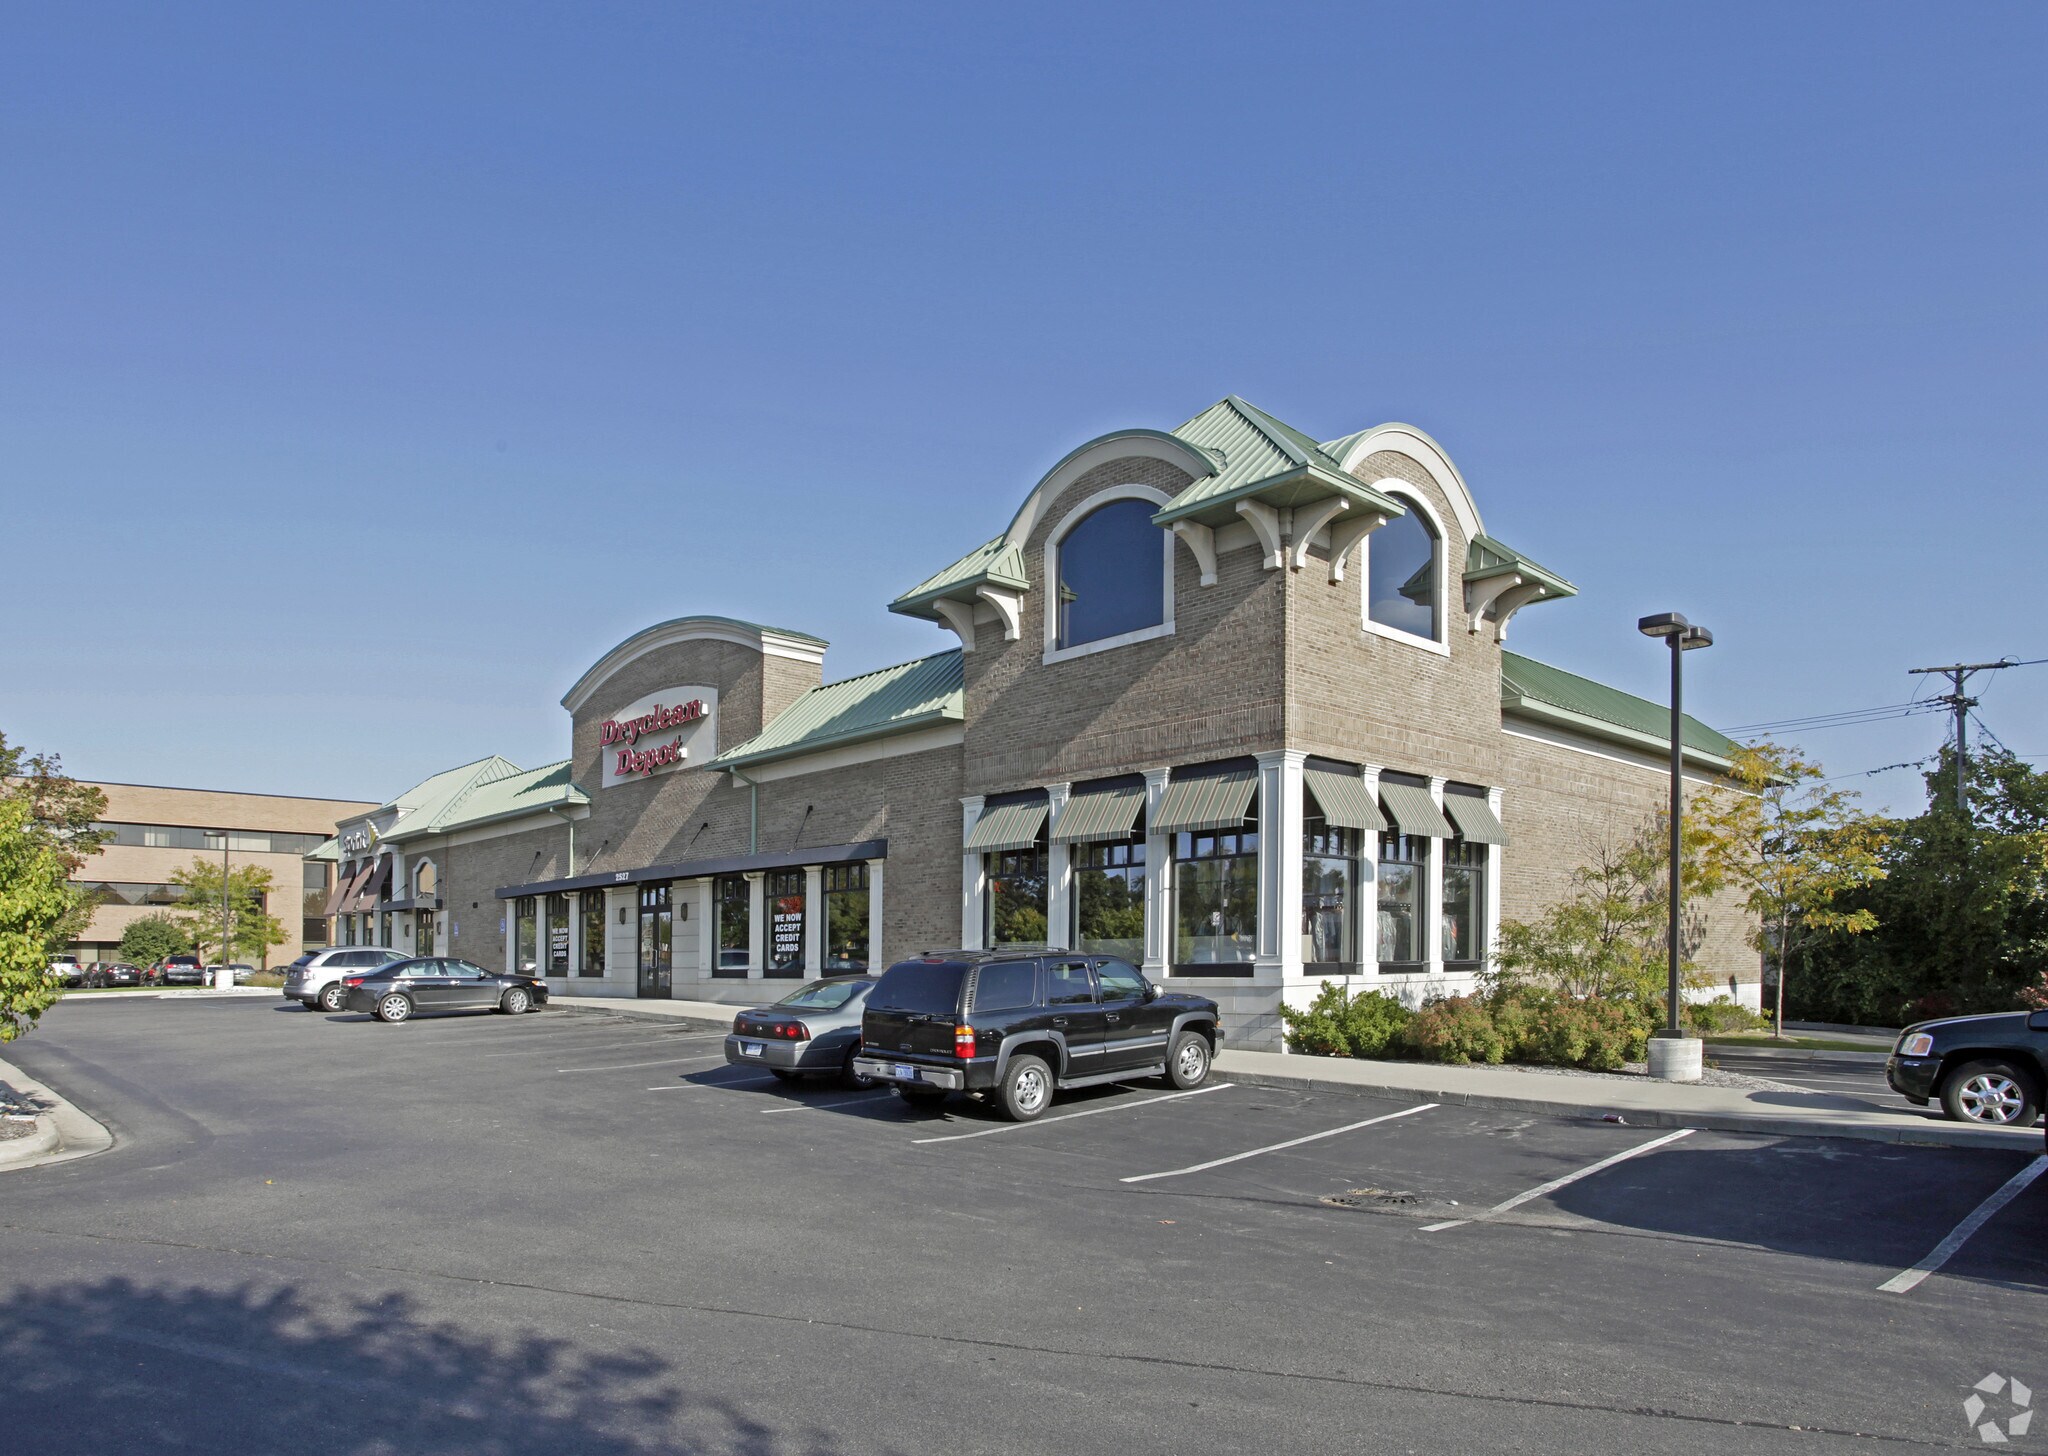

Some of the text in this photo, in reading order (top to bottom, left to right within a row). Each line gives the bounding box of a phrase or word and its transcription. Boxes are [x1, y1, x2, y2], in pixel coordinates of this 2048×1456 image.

[600, 699, 702, 747] Dryclean
[614, 738, 681, 777] Depot
[615, 872, 629, 881] 2527
[774, 912, 802, 922] WE NOW
[774, 923, 801, 932] ACCEPT
[775, 933, 800, 942] CREDIT
[776, 943, 799, 952] CARDS
